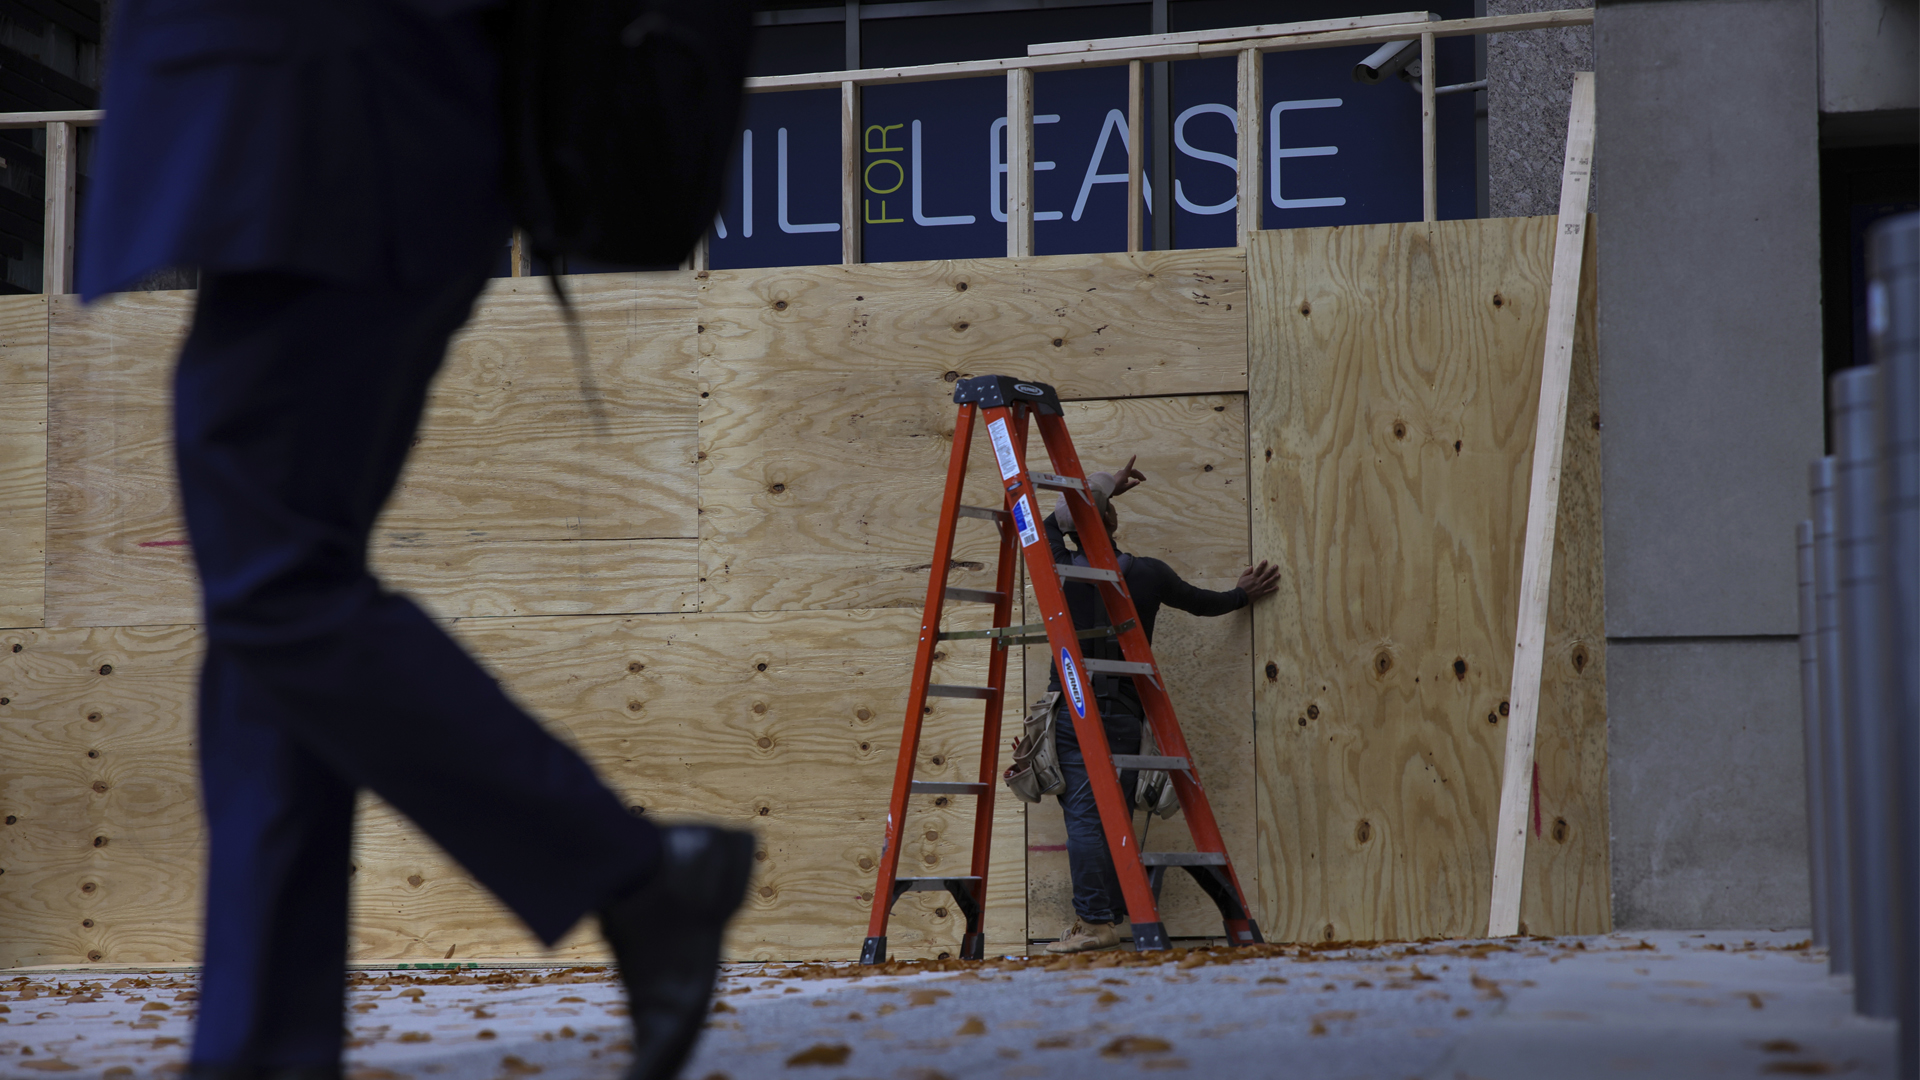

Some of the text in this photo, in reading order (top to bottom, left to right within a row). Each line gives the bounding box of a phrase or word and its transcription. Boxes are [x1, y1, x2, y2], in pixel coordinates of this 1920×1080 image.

[713, 97, 1347, 239] IL FOR LEASE
[1065, 662, 1082, 704] WERNER
